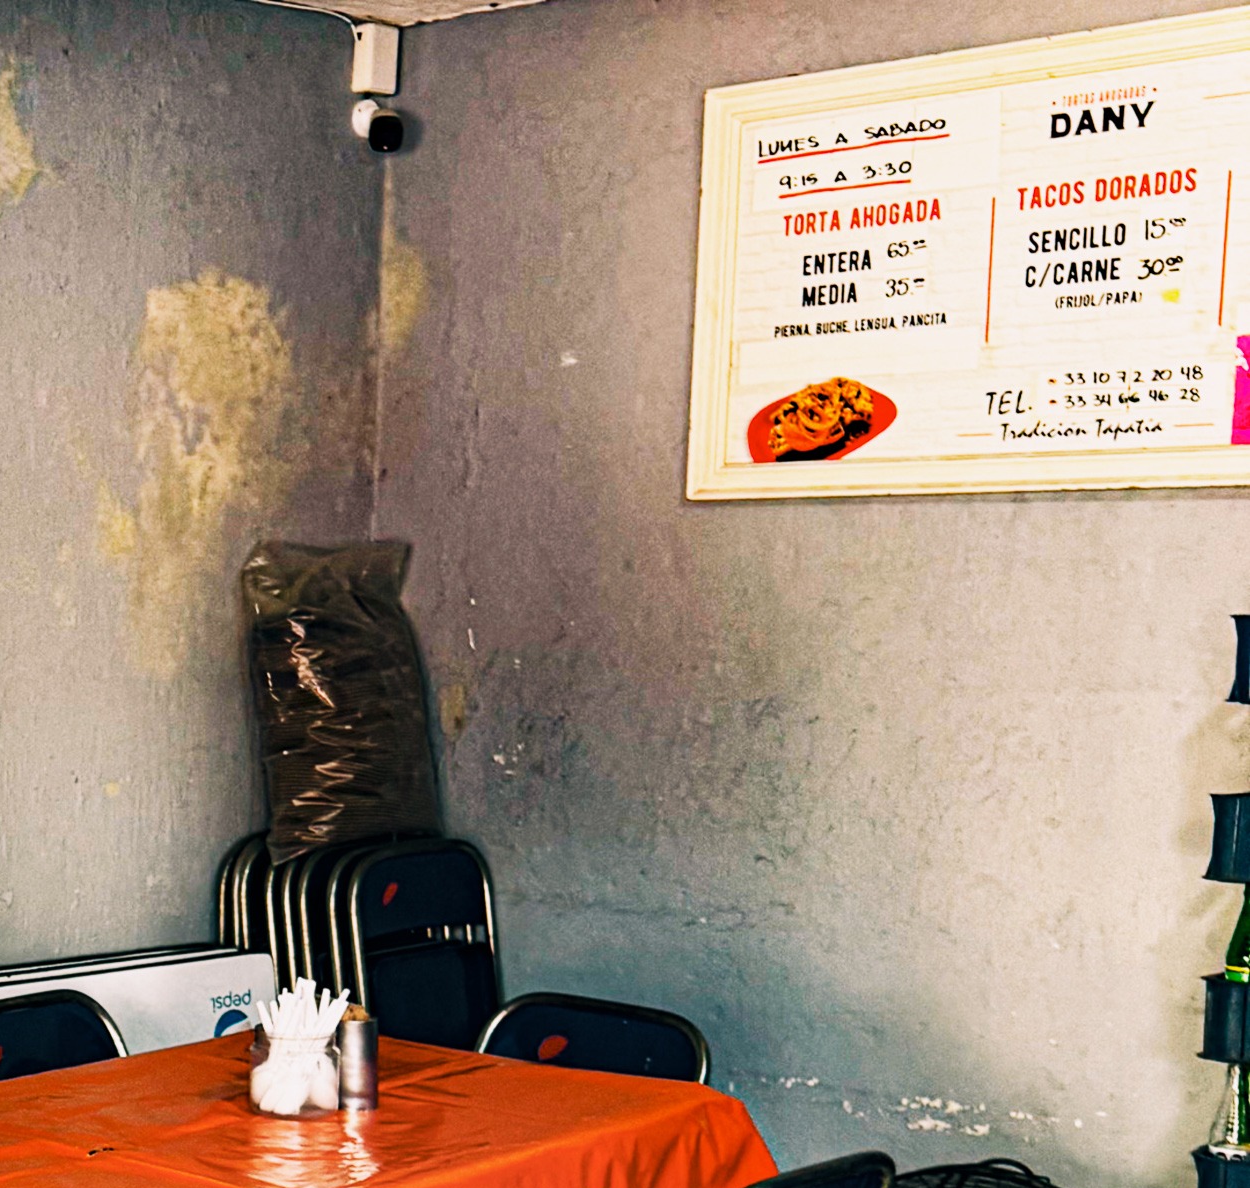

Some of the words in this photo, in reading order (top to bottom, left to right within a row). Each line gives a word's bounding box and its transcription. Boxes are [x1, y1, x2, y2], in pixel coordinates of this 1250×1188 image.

[835, 133, 848, 144] A
[864, 119, 946, 139] SABADO
[1050, 101, 1155, 138] DANY
[779, 173, 818, 189] 9:15
[834, 171, 847, 182] A
[862, 161, 912, 179] 3:30
[1018, 181, 1085, 210] TACOS
[1095, 168, 1197, 202] DORADOS
[784, 210, 840, 236] TORTA
[850, 198, 941, 229] AHOGADA
[1028, 223, 1126, 253] SENCILLO
[803, 250, 871, 276] ENTERA
[1025, 258, 1121, 288] C/CARNE
[802, 283, 857, 307] MEDIA
[1055, 291, 1142, 309] (FRIJOL/PAPA)
[902, 313, 947, 327] PANCITA
[1064, 373, 1085, 384] 33
[1093, 371, 1110, 383] 10
[1152, 369, 1171, 381] 20
[1180, 365, 1203, 380] 48
[986, 390, 1032, 415] TEL.
[1065, 395, 1086, 408] 33
[1094, 394, 1111, 407] 34
[1180, 388, 1200, 402] 28
[211, 989, 251, 1013] pepsi
